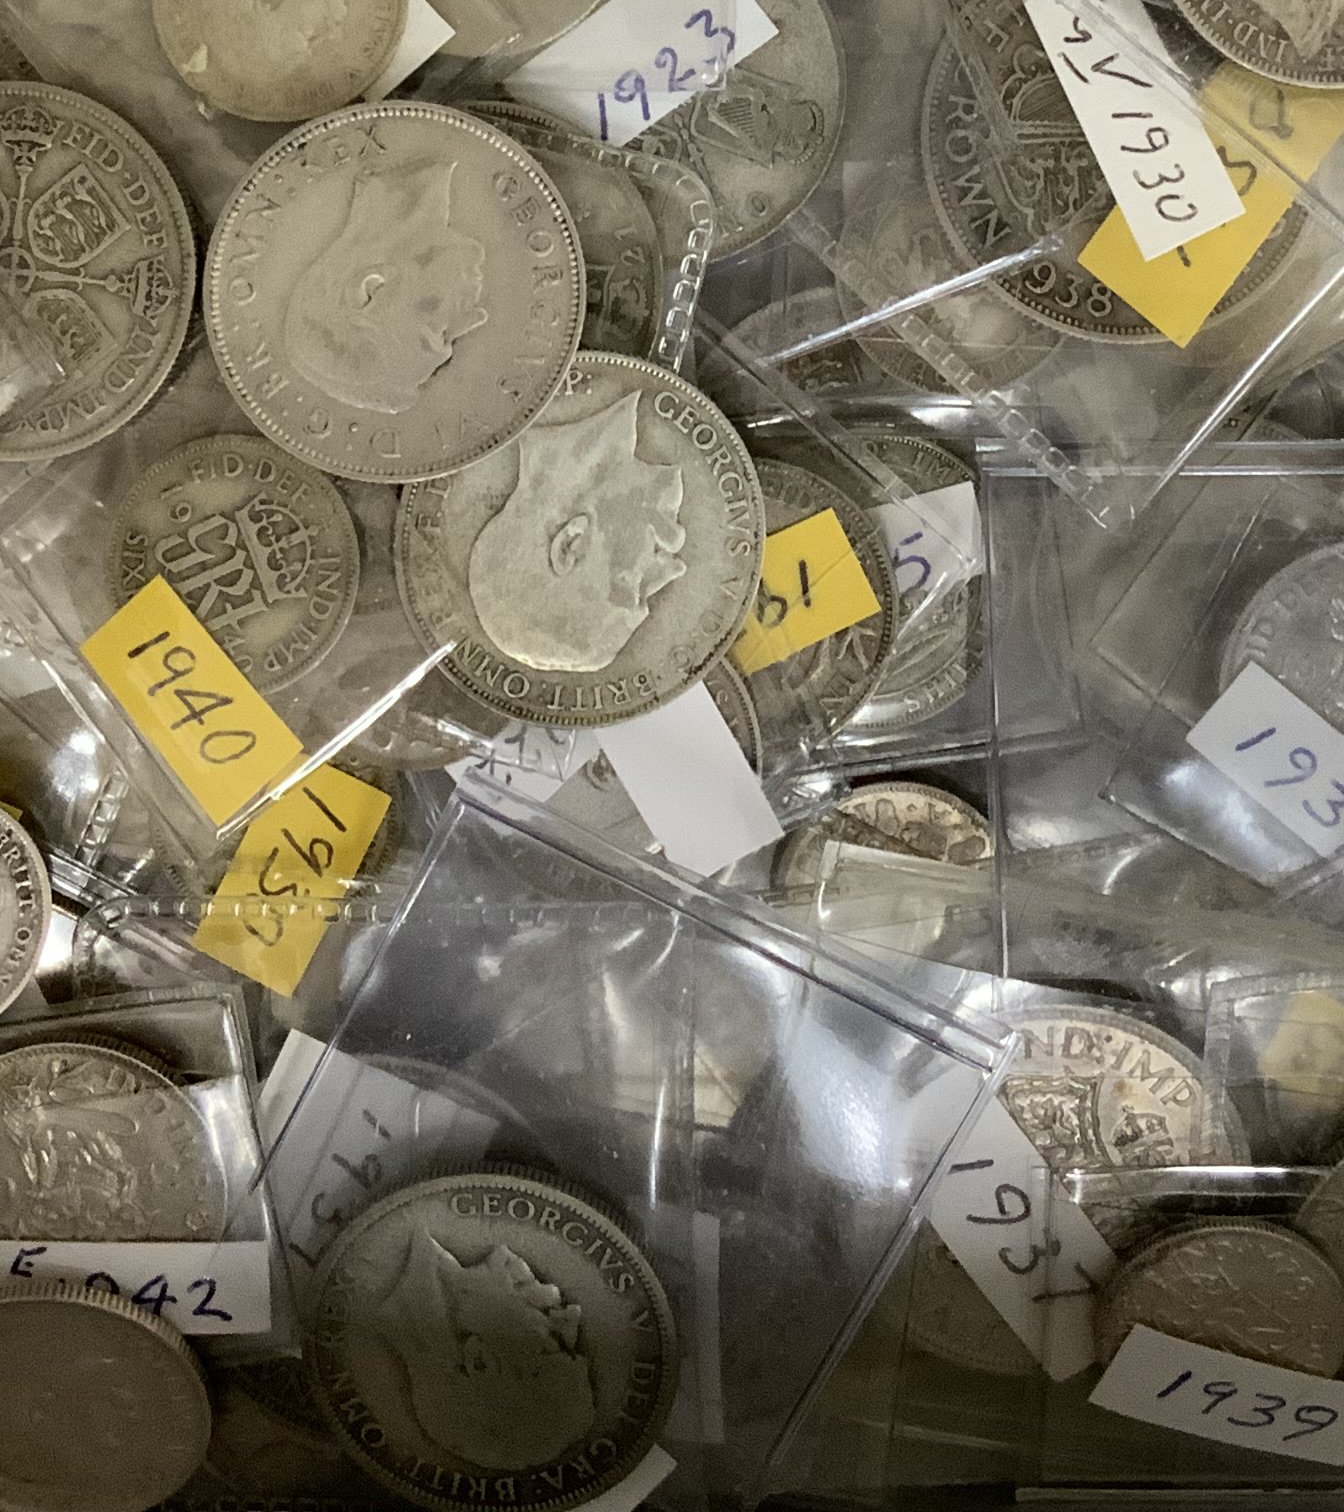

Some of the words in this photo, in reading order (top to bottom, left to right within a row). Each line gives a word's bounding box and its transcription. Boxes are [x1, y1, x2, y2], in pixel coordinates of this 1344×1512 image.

[595, 8, 738, 142] 1923
[1112, 109, 1199, 224] 1930
[127, 630, 258, 764] 1940
[1155, 1370, 1340, 1443] 1939
